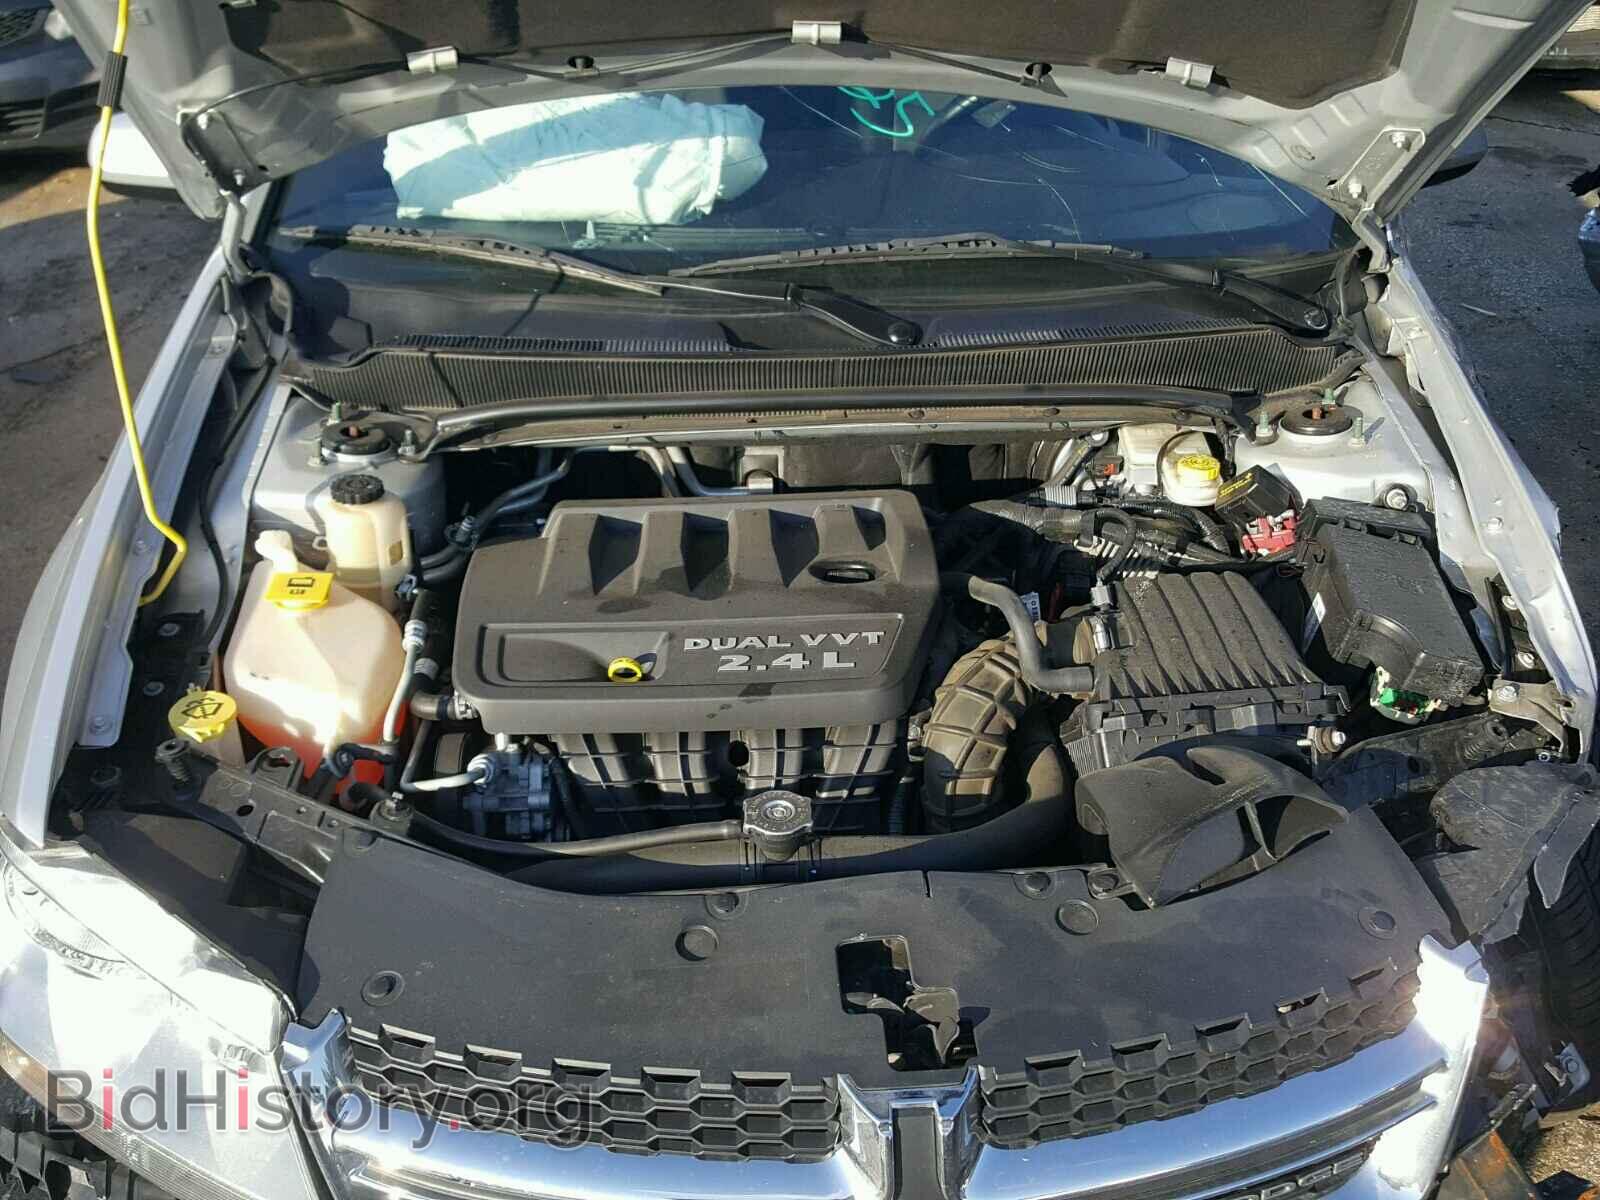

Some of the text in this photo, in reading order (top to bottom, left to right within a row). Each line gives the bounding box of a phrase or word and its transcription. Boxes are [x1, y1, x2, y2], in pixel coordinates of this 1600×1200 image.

[684, 631, 886, 651] DUAL VVT
[823, 651, 856, 669] L
